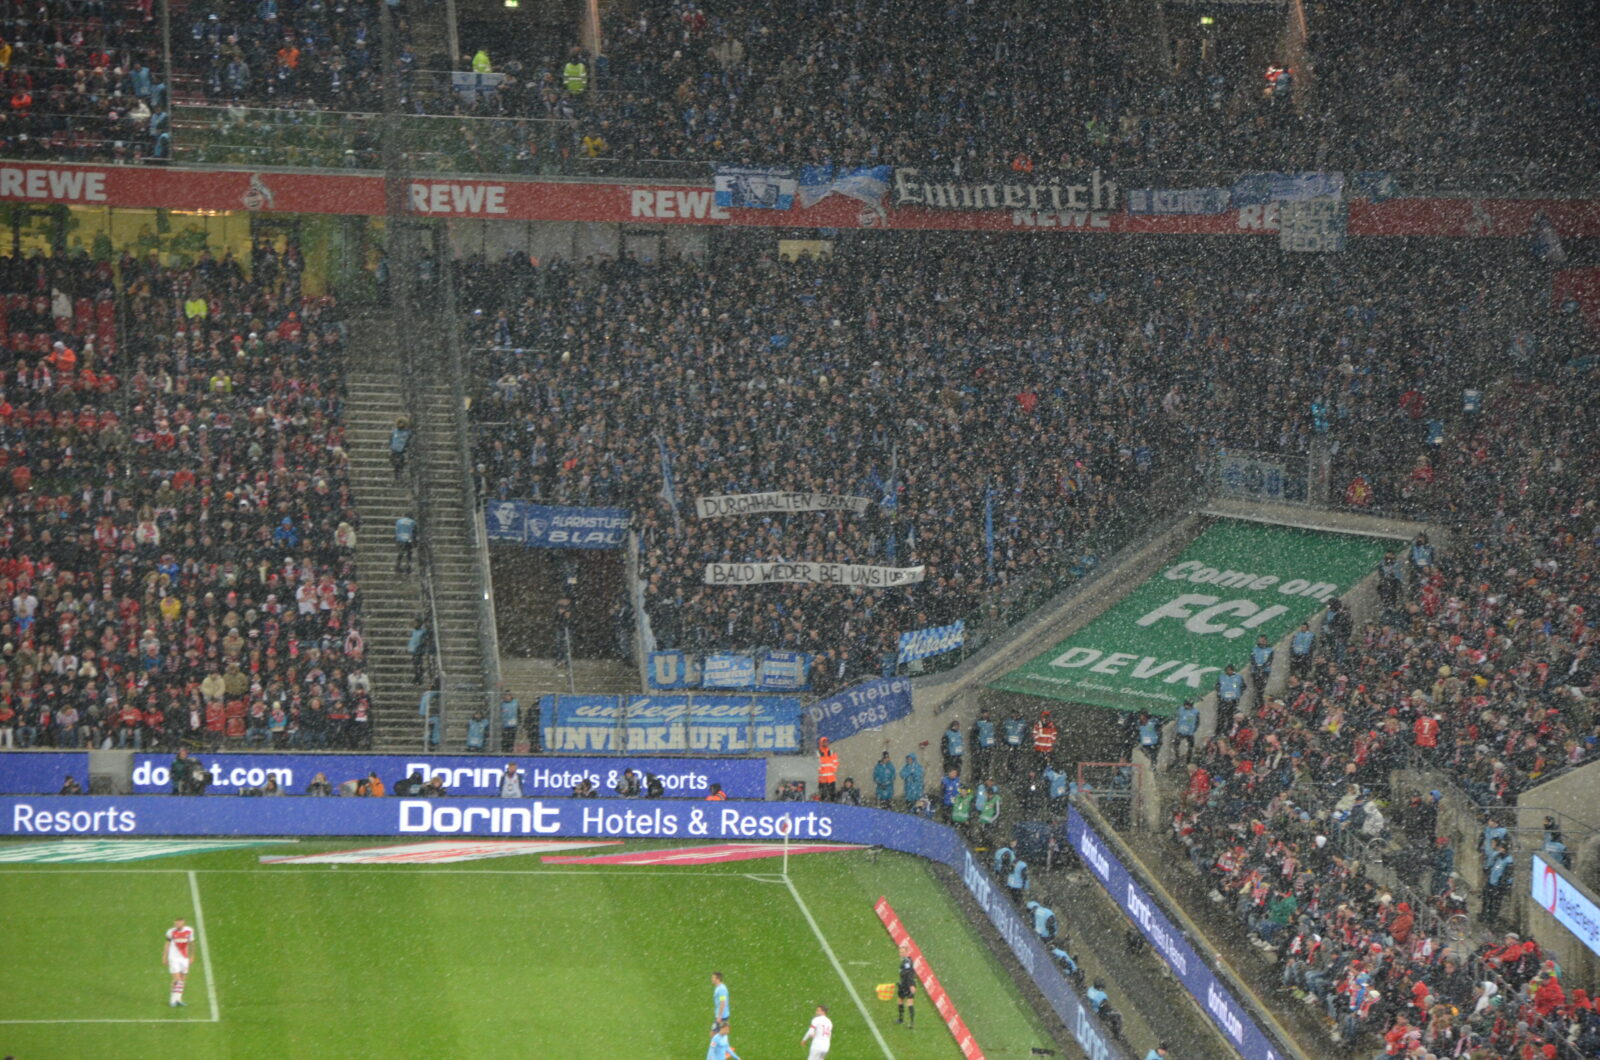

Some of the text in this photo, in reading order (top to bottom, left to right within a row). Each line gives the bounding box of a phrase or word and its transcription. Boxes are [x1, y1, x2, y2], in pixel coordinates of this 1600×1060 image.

[0, 168, 107, 201] REWE
[409, 184, 508, 214] REWE
[895, 167, 1119, 210] Emmerich
[704, 493, 812, 516] DURCHHALTEN
[548, 531, 628, 544] BLAU
[713, 565, 754, 583] BALD
[761, 565, 814, 583] WIEDER
[820, 565, 843, 583] BEI
[1164, 560, 1340, 603] Come on,
[1136, 593, 1289, 638] FC!
[1049, 646, 1223, 688] DEVK
[575, 698, 766, 723] unbequem
[810, 680, 911, 723] Die Treuen
[850, 705, 888, 729] 1983
[132, 760, 293, 788] dot.com
[13, 804, 137, 832] Resorts
[398, 801, 833, 837] Dorint Hotels & Resorts
